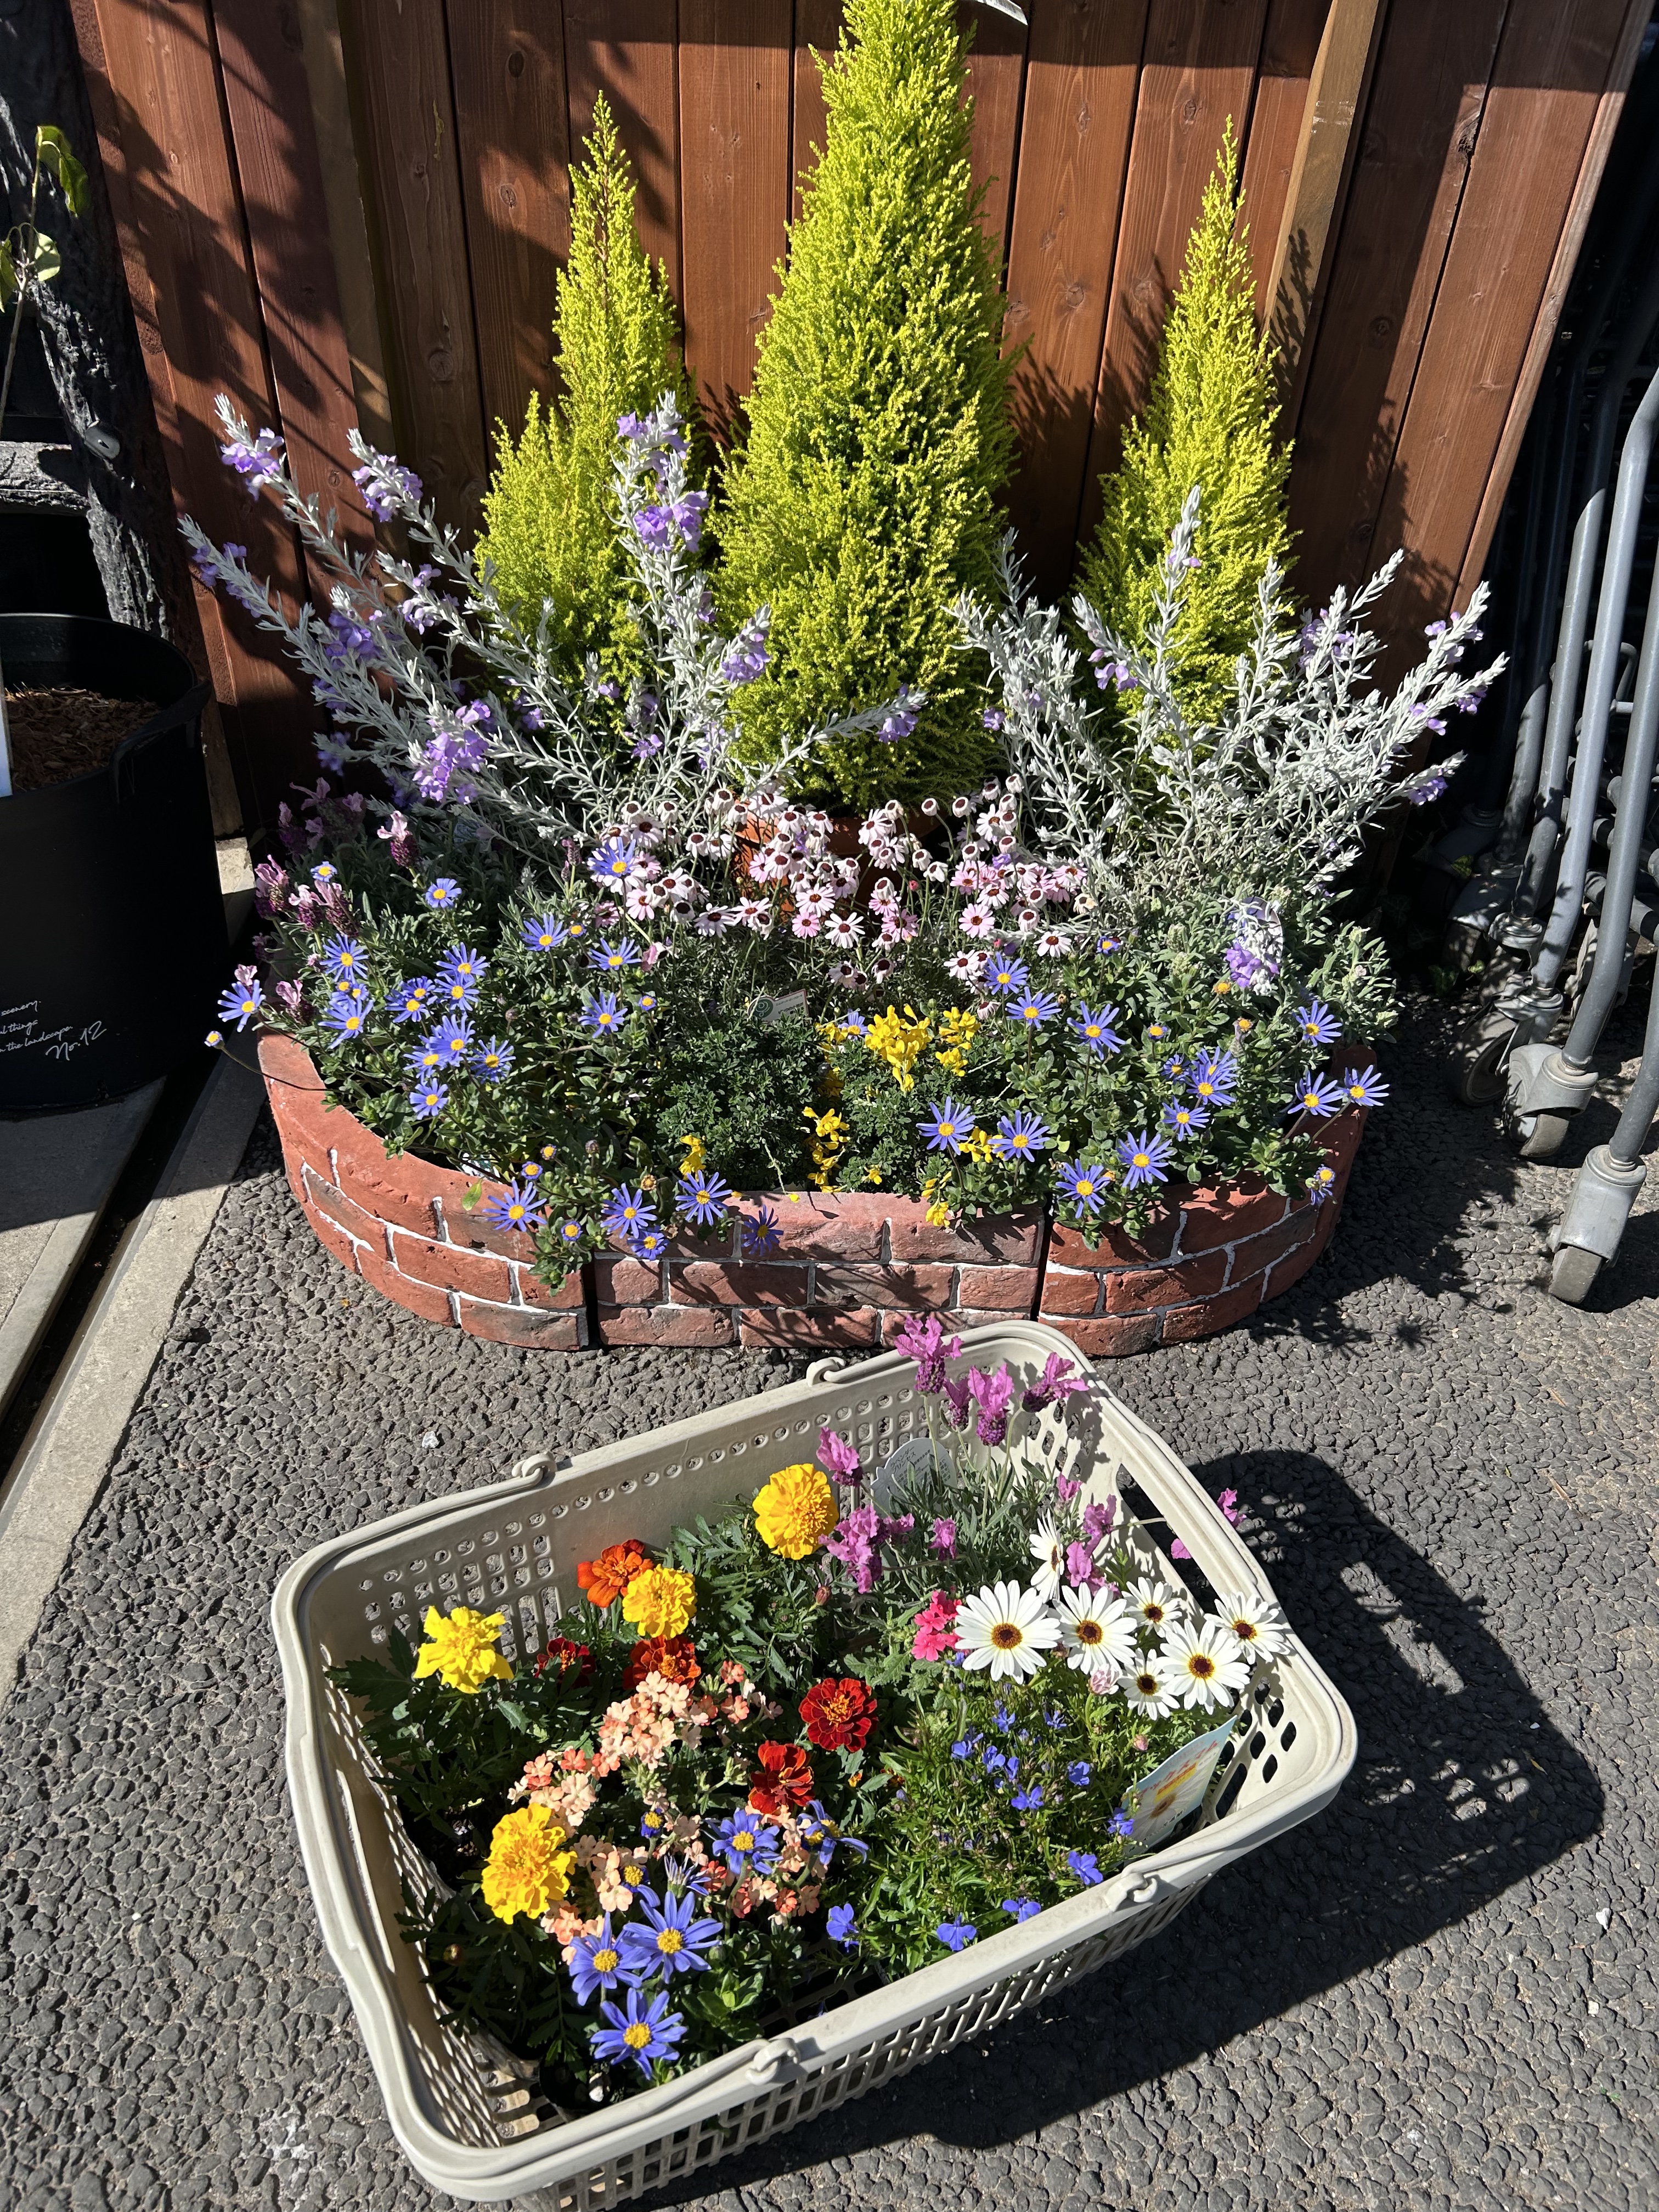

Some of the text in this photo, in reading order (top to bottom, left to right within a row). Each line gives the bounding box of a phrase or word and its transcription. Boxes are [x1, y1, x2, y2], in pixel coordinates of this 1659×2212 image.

[7, 1020, 38, 1036] things
[5, 1042, 23, 1051] the
[24, 1026, 74, 1047] landscape.
